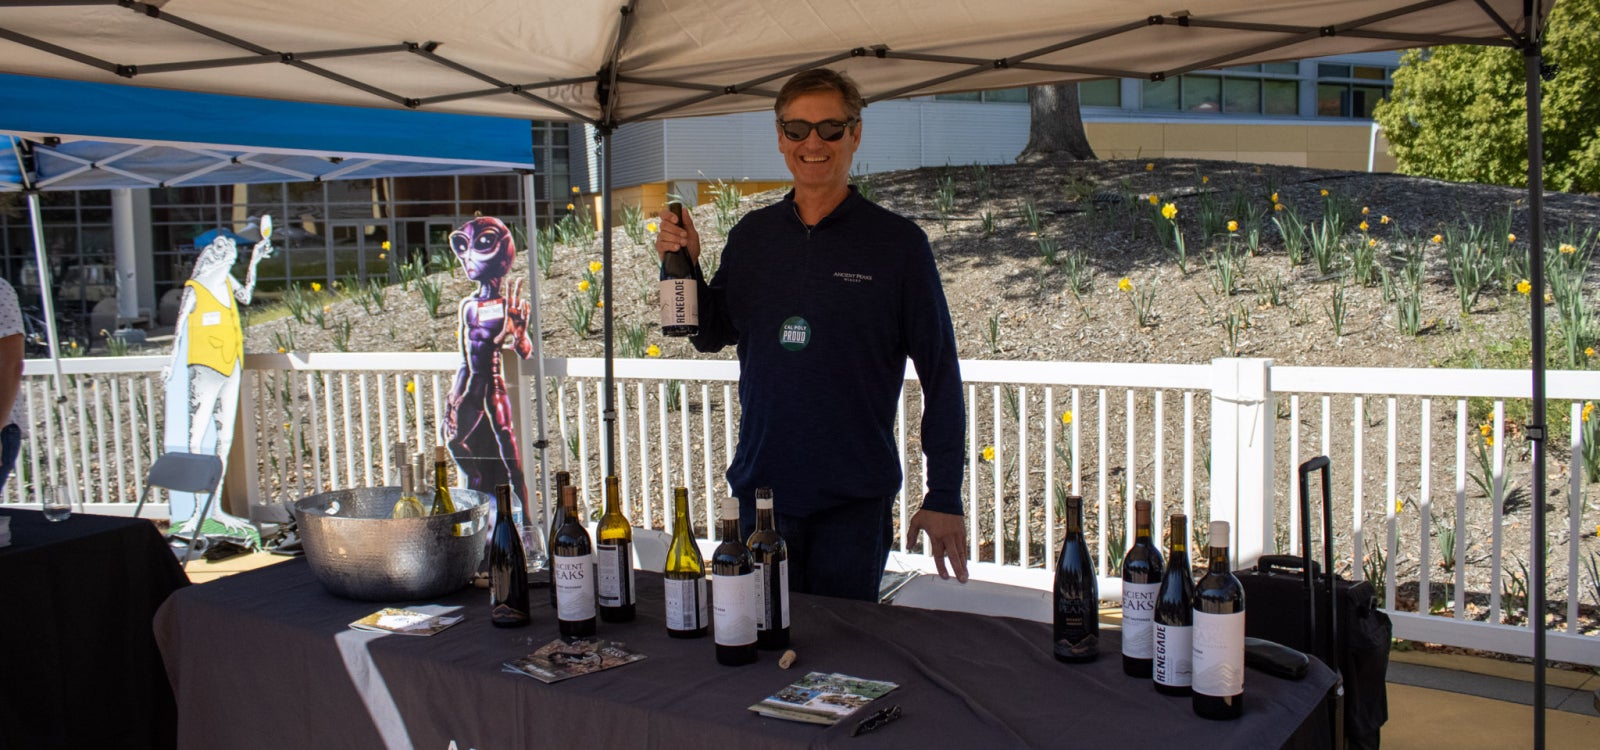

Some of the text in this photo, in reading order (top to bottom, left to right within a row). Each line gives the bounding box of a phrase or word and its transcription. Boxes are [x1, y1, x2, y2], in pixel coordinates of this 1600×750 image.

[675, 280, 685, 323] RENEGADE
[783, 330, 806, 342] PROUD
[556, 570, 584, 580] EAKS
[1123, 599, 1154, 611] EAKS
[1156, 625, 1166, 682] RENEGADE
